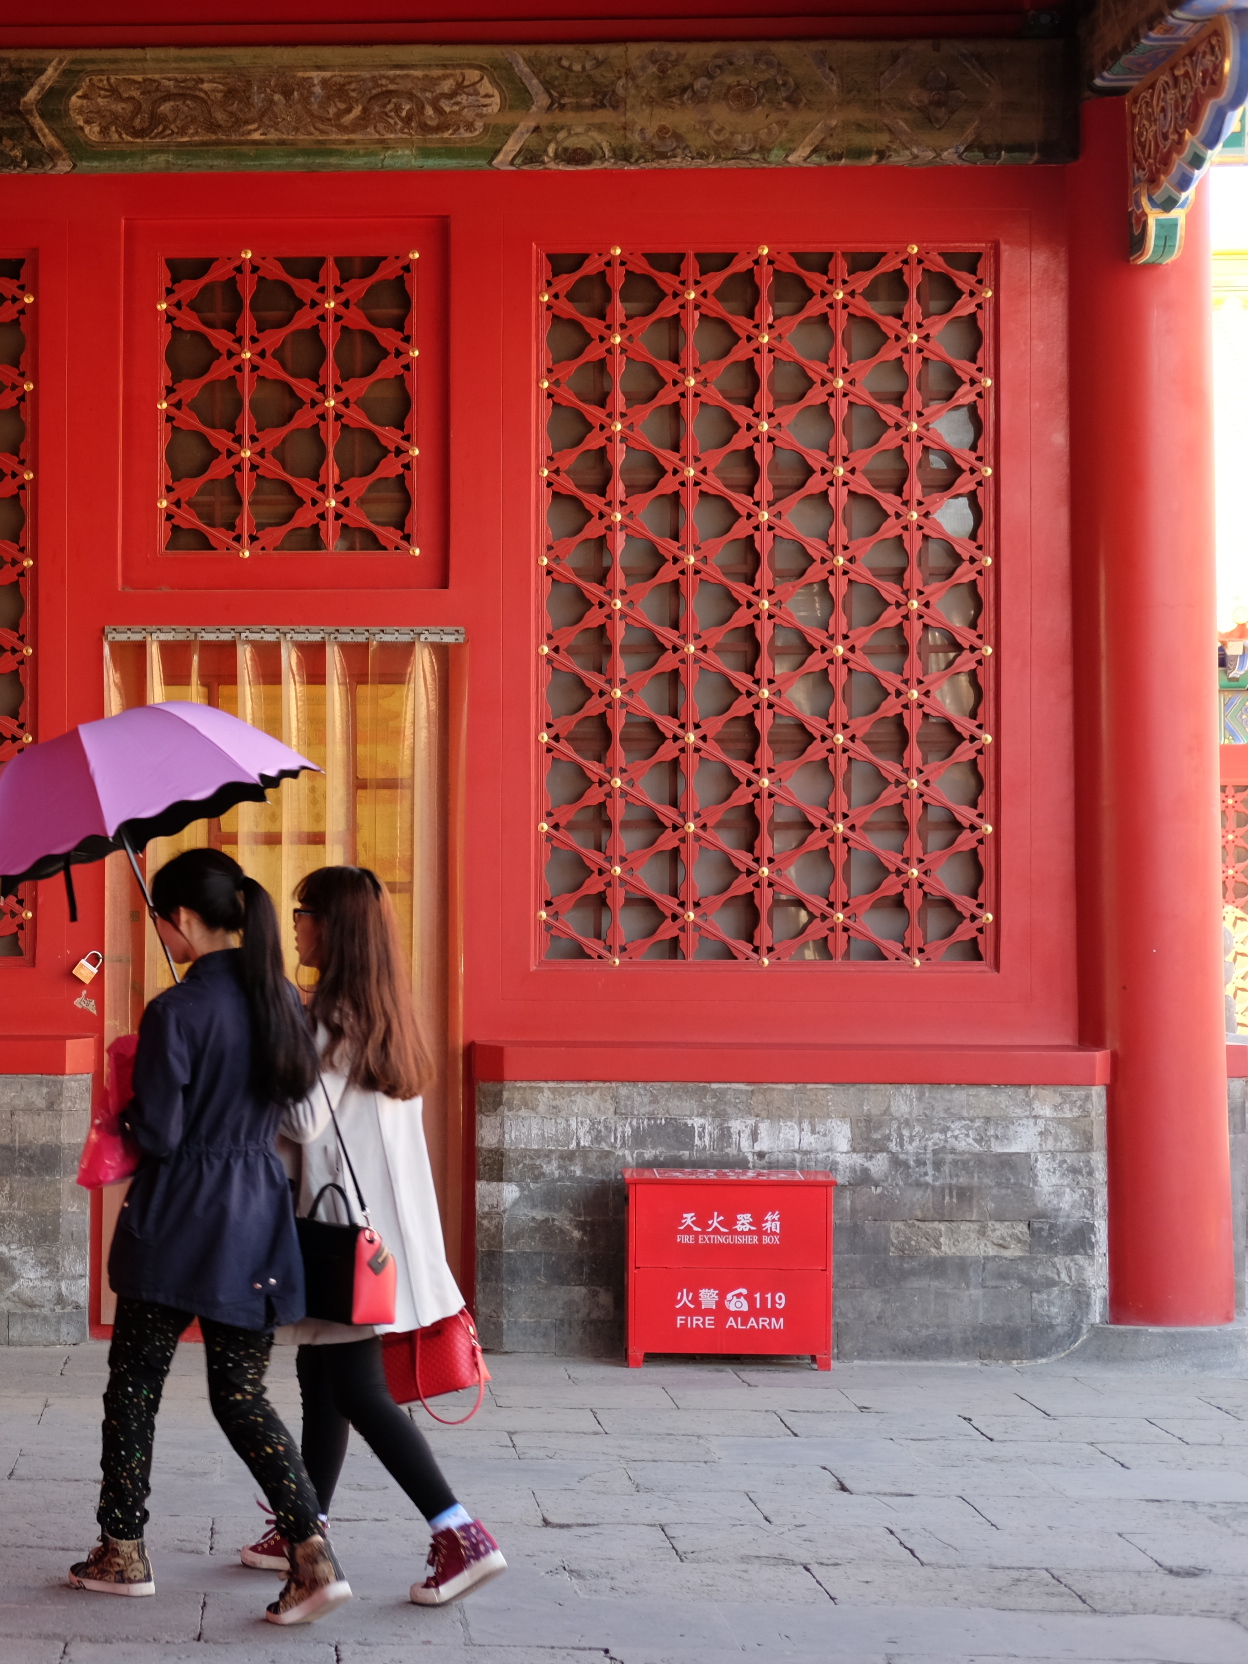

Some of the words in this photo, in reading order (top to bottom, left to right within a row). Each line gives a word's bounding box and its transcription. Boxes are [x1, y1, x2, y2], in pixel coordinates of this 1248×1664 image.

[677, 1210, 780, 1234] 灭火器箱
[677, 1235, 695, 1244] FIRE
[698, 1235, 759, 1244] EXTINGUISHER
[762, 1235, 780, 1244] BOX
[674, 1288, 719, 1310] 火警
[753, 1292, 786, 1309] 119
[676, 1316, 715, 1328] FIRE
[725, 1317, 784, 1330] ALARM
